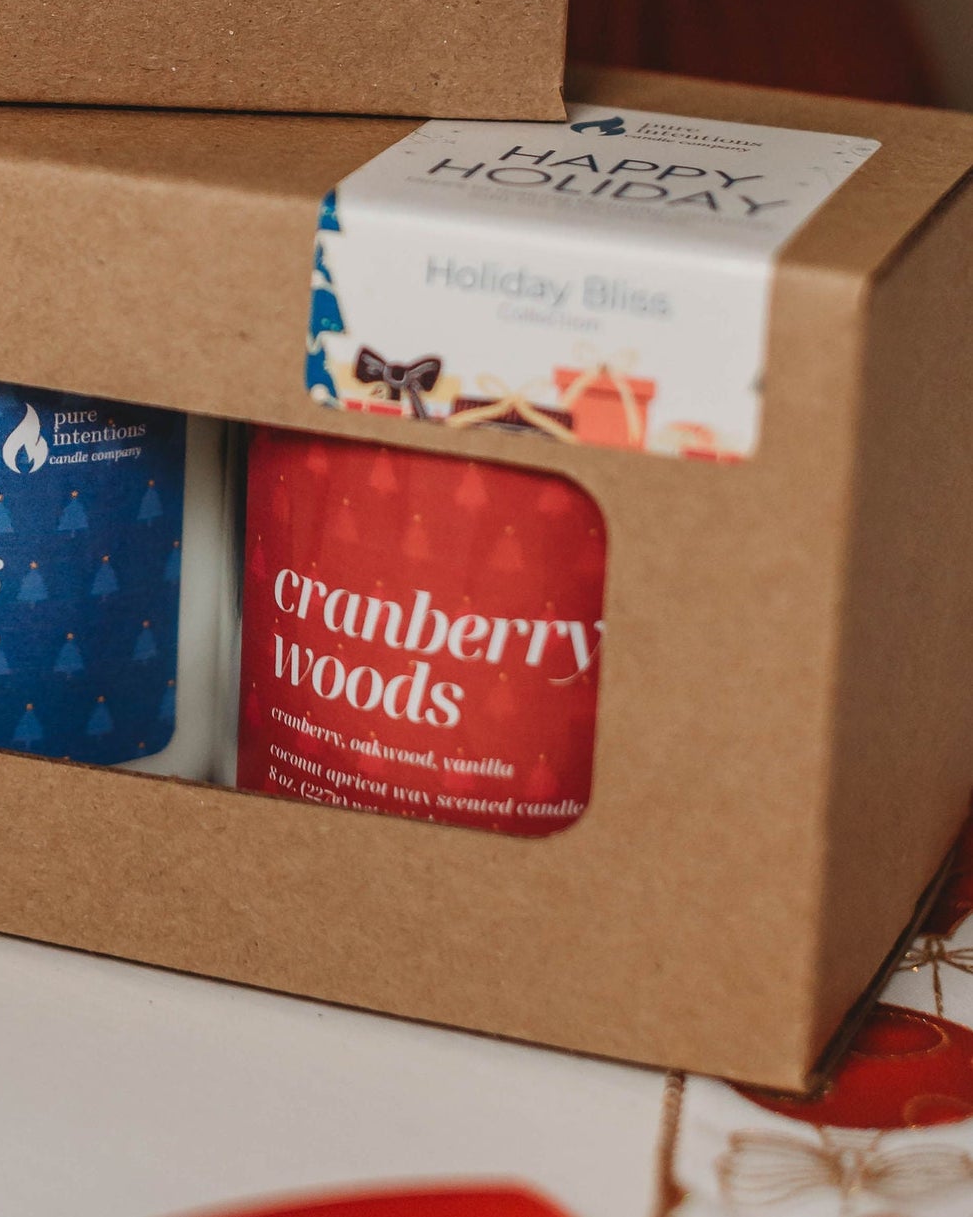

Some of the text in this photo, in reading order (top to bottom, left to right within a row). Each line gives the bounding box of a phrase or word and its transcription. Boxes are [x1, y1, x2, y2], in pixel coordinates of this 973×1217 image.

[498, 145, 764, 188] HAPPY
[678, 140, 750, 152] company
[427, 158, 787, 216] HOLIDAY
[425, 255, 672, 318] Holiday Bliss
[53, 423, 147, 446] intentions
[54, 410, 98, 430] pure
[49, 447, 142, 465] candle company
[273, 568, 605, 684] cranberry
[273, 633, 465, 729] woods
[271, 706, 515, 779] cranberry, oakwood, vanilla
[268, 765, 277, 780] 8
[270, 744, 322, 778] coconut
[325, 766, 388, 797] apricot
[393, 785, 431, 806] wax
[436, 791, 513, 816] scented
[516, 799, 585, 817] candle
